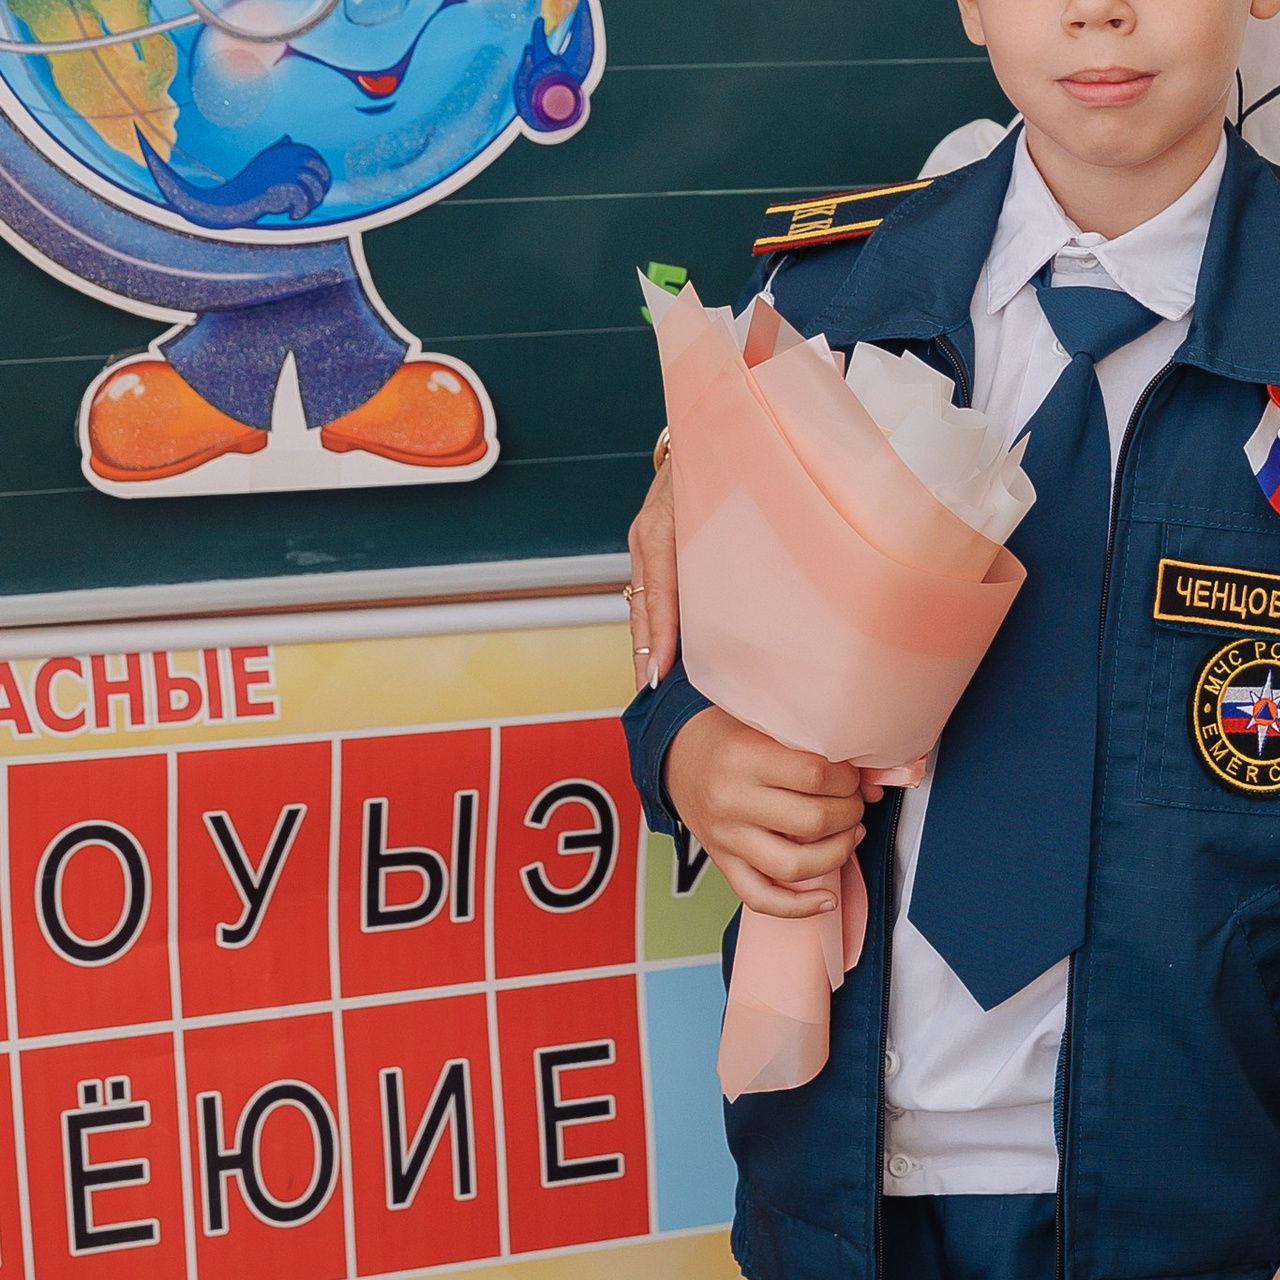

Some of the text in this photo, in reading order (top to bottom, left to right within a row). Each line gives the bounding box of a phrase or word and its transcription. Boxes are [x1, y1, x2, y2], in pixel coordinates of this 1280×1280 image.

[1203, 649, 1243, 696] МЧС
[39, 823, 148, 963] О
[205, 806, 304, 946] У
[365, 792, 478, 931] Ы
[523, 781, 618, 912] Э
[65, 1041, 624, 1254] Ё Ю И Е
